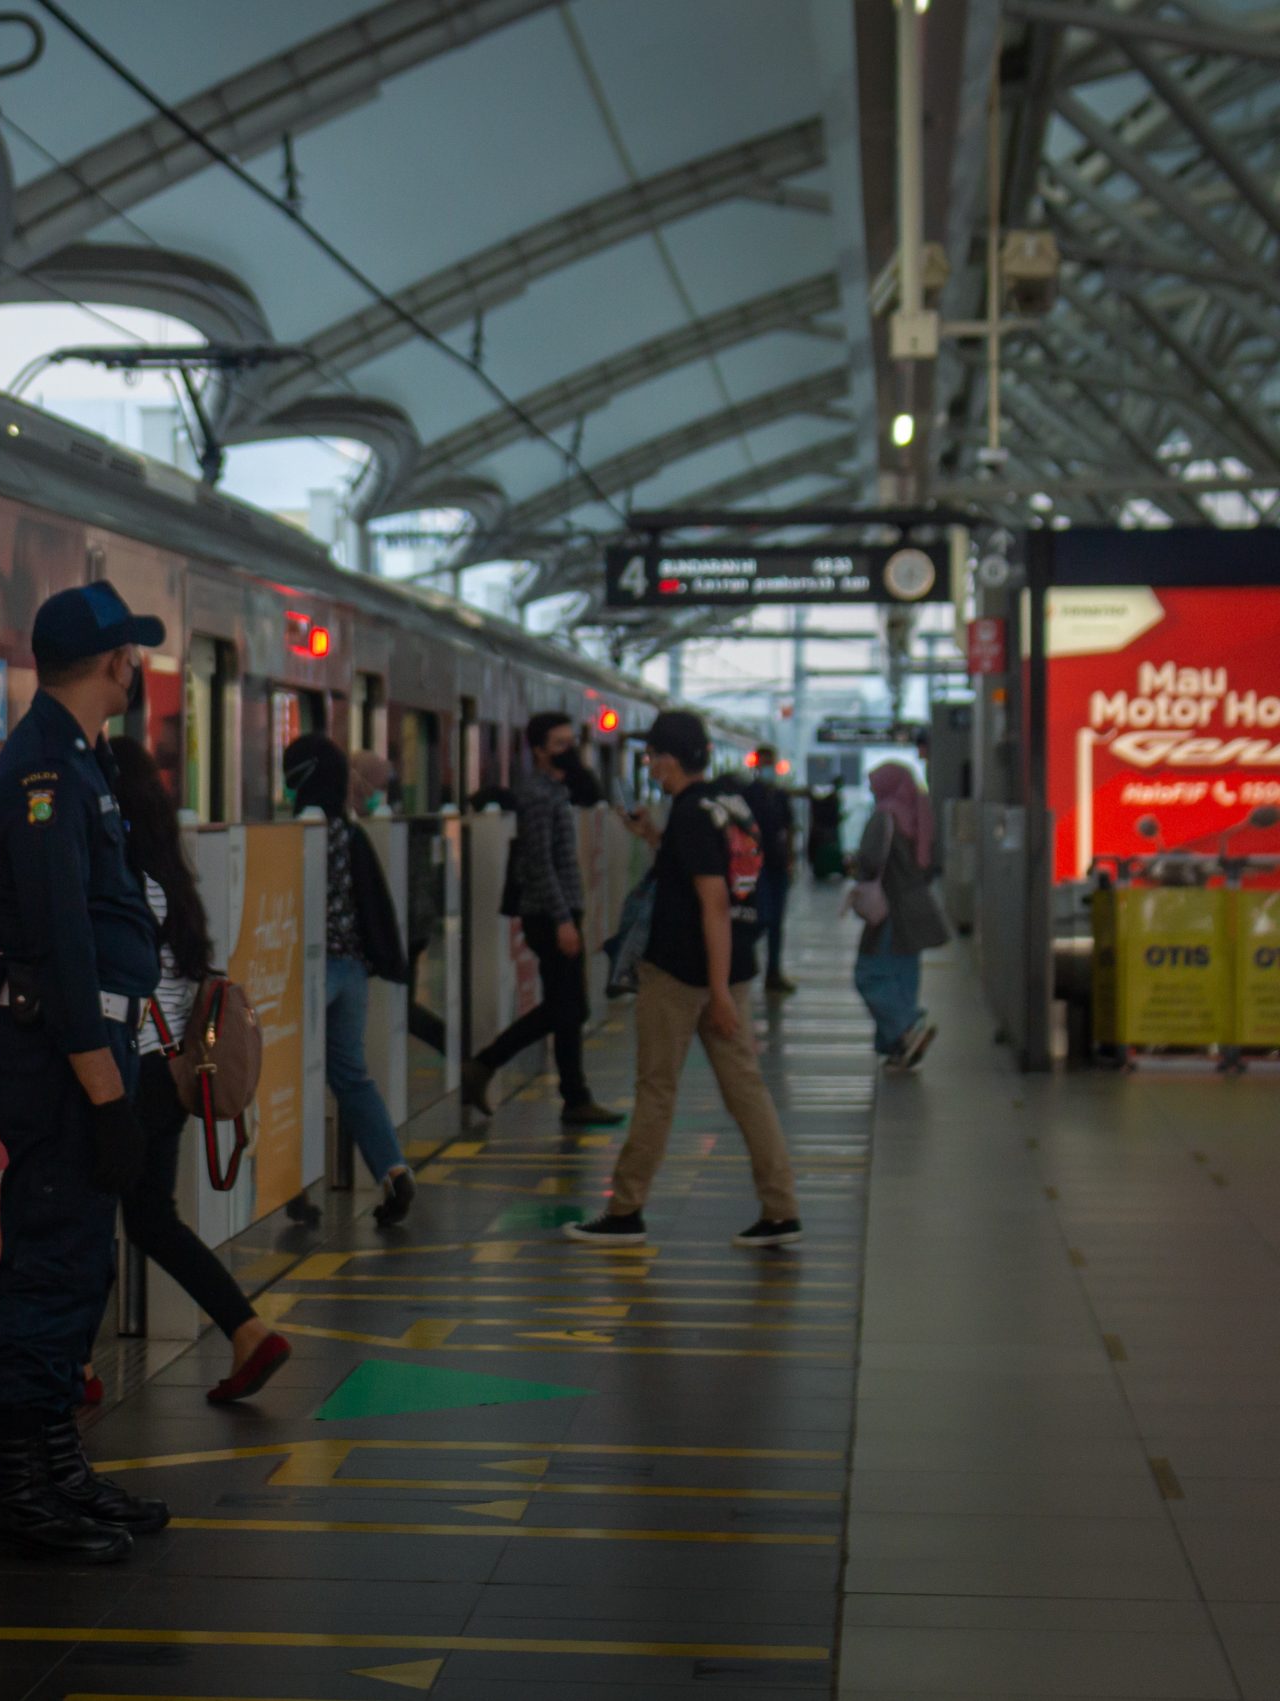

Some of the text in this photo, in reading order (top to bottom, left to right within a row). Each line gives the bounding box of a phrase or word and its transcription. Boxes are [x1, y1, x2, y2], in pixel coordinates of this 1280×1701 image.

[617, 555, 648, 600] 4
[1138, 661, 1227, 697] Mau
[1090, 690, 1218, 727] Motor
[20, 771, 59, 787] POLDA
[1145, 944, 1211, 968] OTIS
